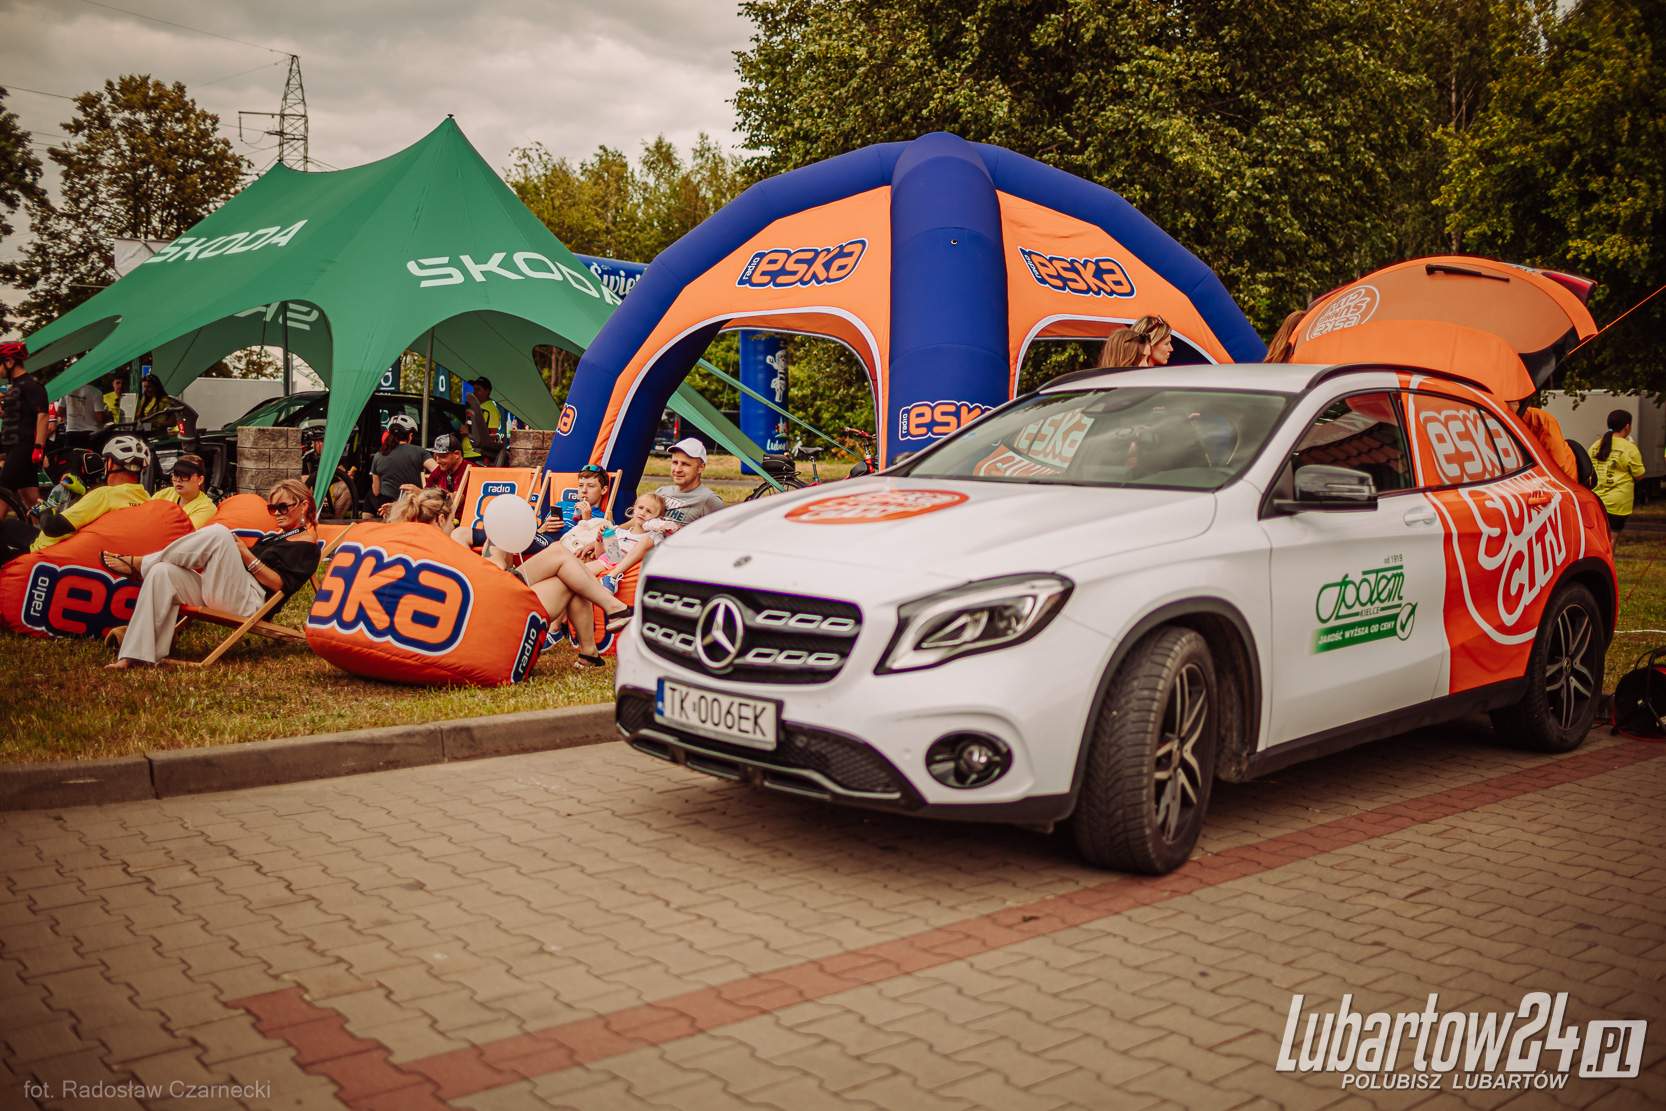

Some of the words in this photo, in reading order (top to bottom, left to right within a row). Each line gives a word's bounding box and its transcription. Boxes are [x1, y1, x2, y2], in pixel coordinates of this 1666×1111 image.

[751, 242, 863, 284] eska
[1030, 254, 1132, 294] eska
[488, 484, 511, 493] radio
[31, 576, 49, 617] radio
[309, 552, 464, 644] ska
[1360, 607, 1380, 617] KIELCE
[1344, 625, 1369, 639] WYŻSZA
[1370, 624, 1379, 633] OD
[1380, 621, 1395, 631] CENY
[518, 628, 537, 674] radio
[669, 686, 690, 720] TK
[698, 695, 767, 737] 006EK
